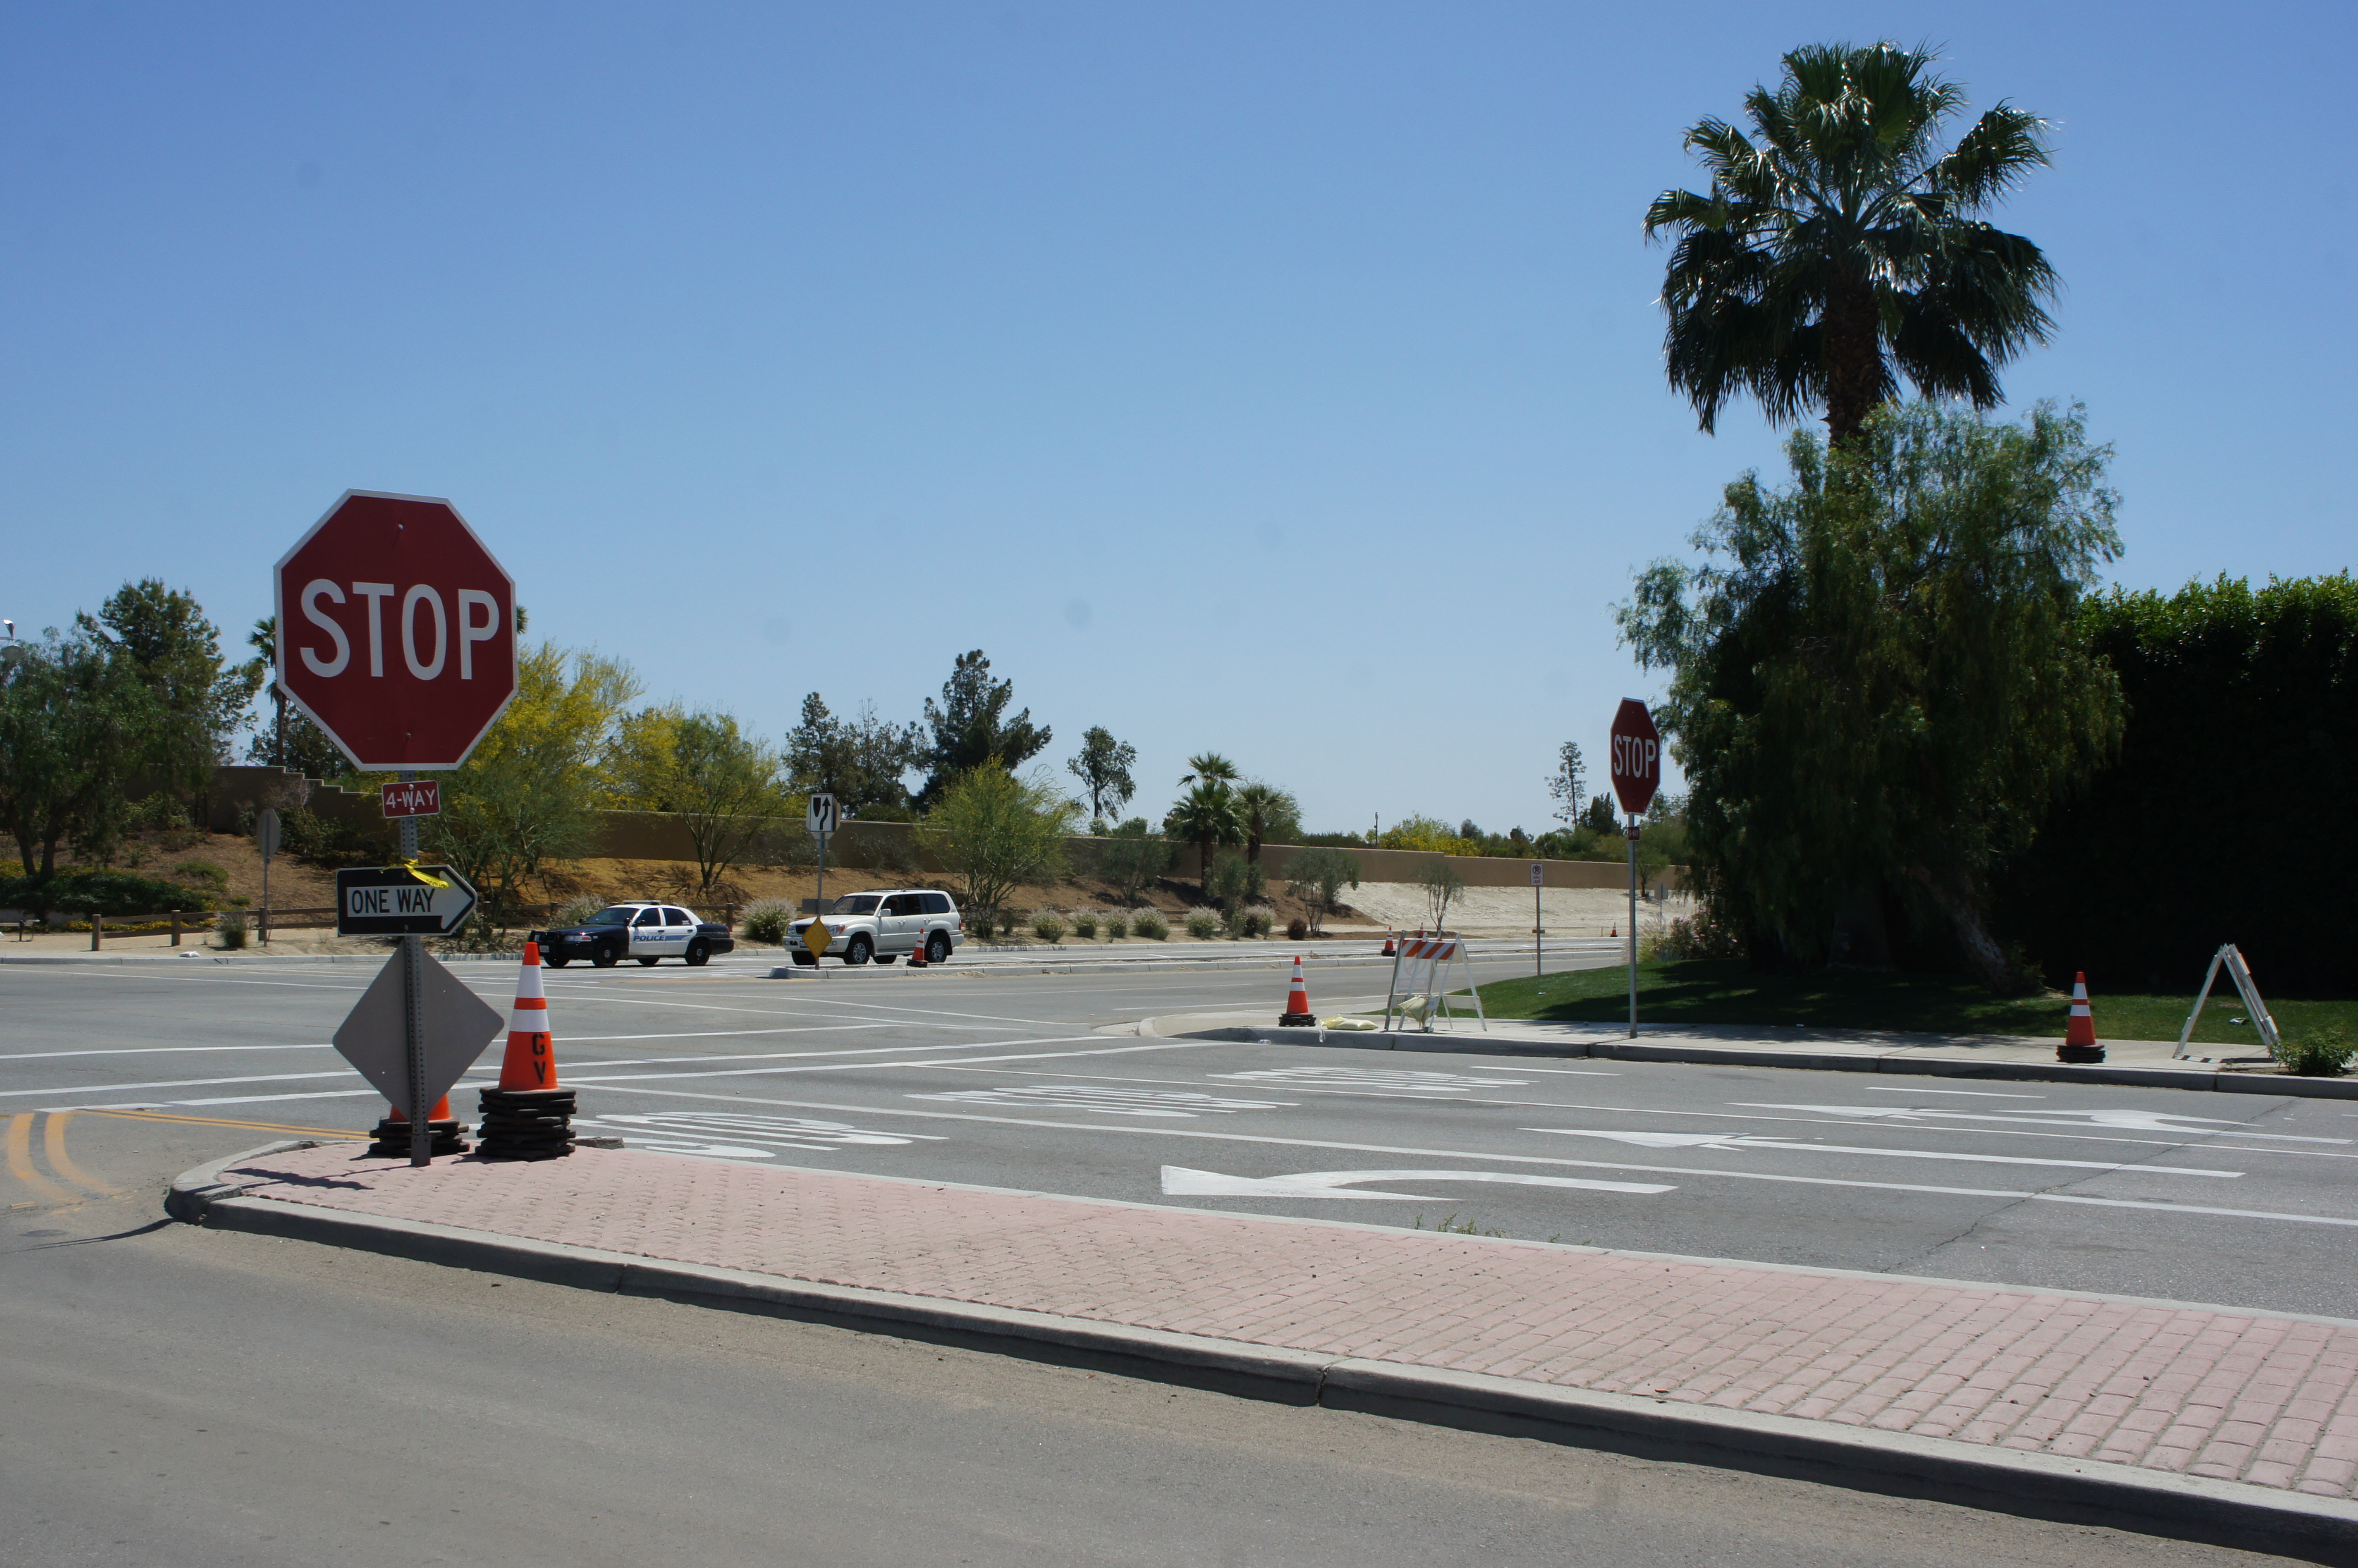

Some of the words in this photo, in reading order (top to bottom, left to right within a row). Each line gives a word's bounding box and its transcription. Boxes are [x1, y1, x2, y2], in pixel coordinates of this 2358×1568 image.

[300, 578, 500, 680] STOP
[1613, 734, 1656, 778] STOP
[386, 789, 436, 809] 4-WAY
[352, 890, 391, 914] ONE
[397, 888, 436, 913] WAY
